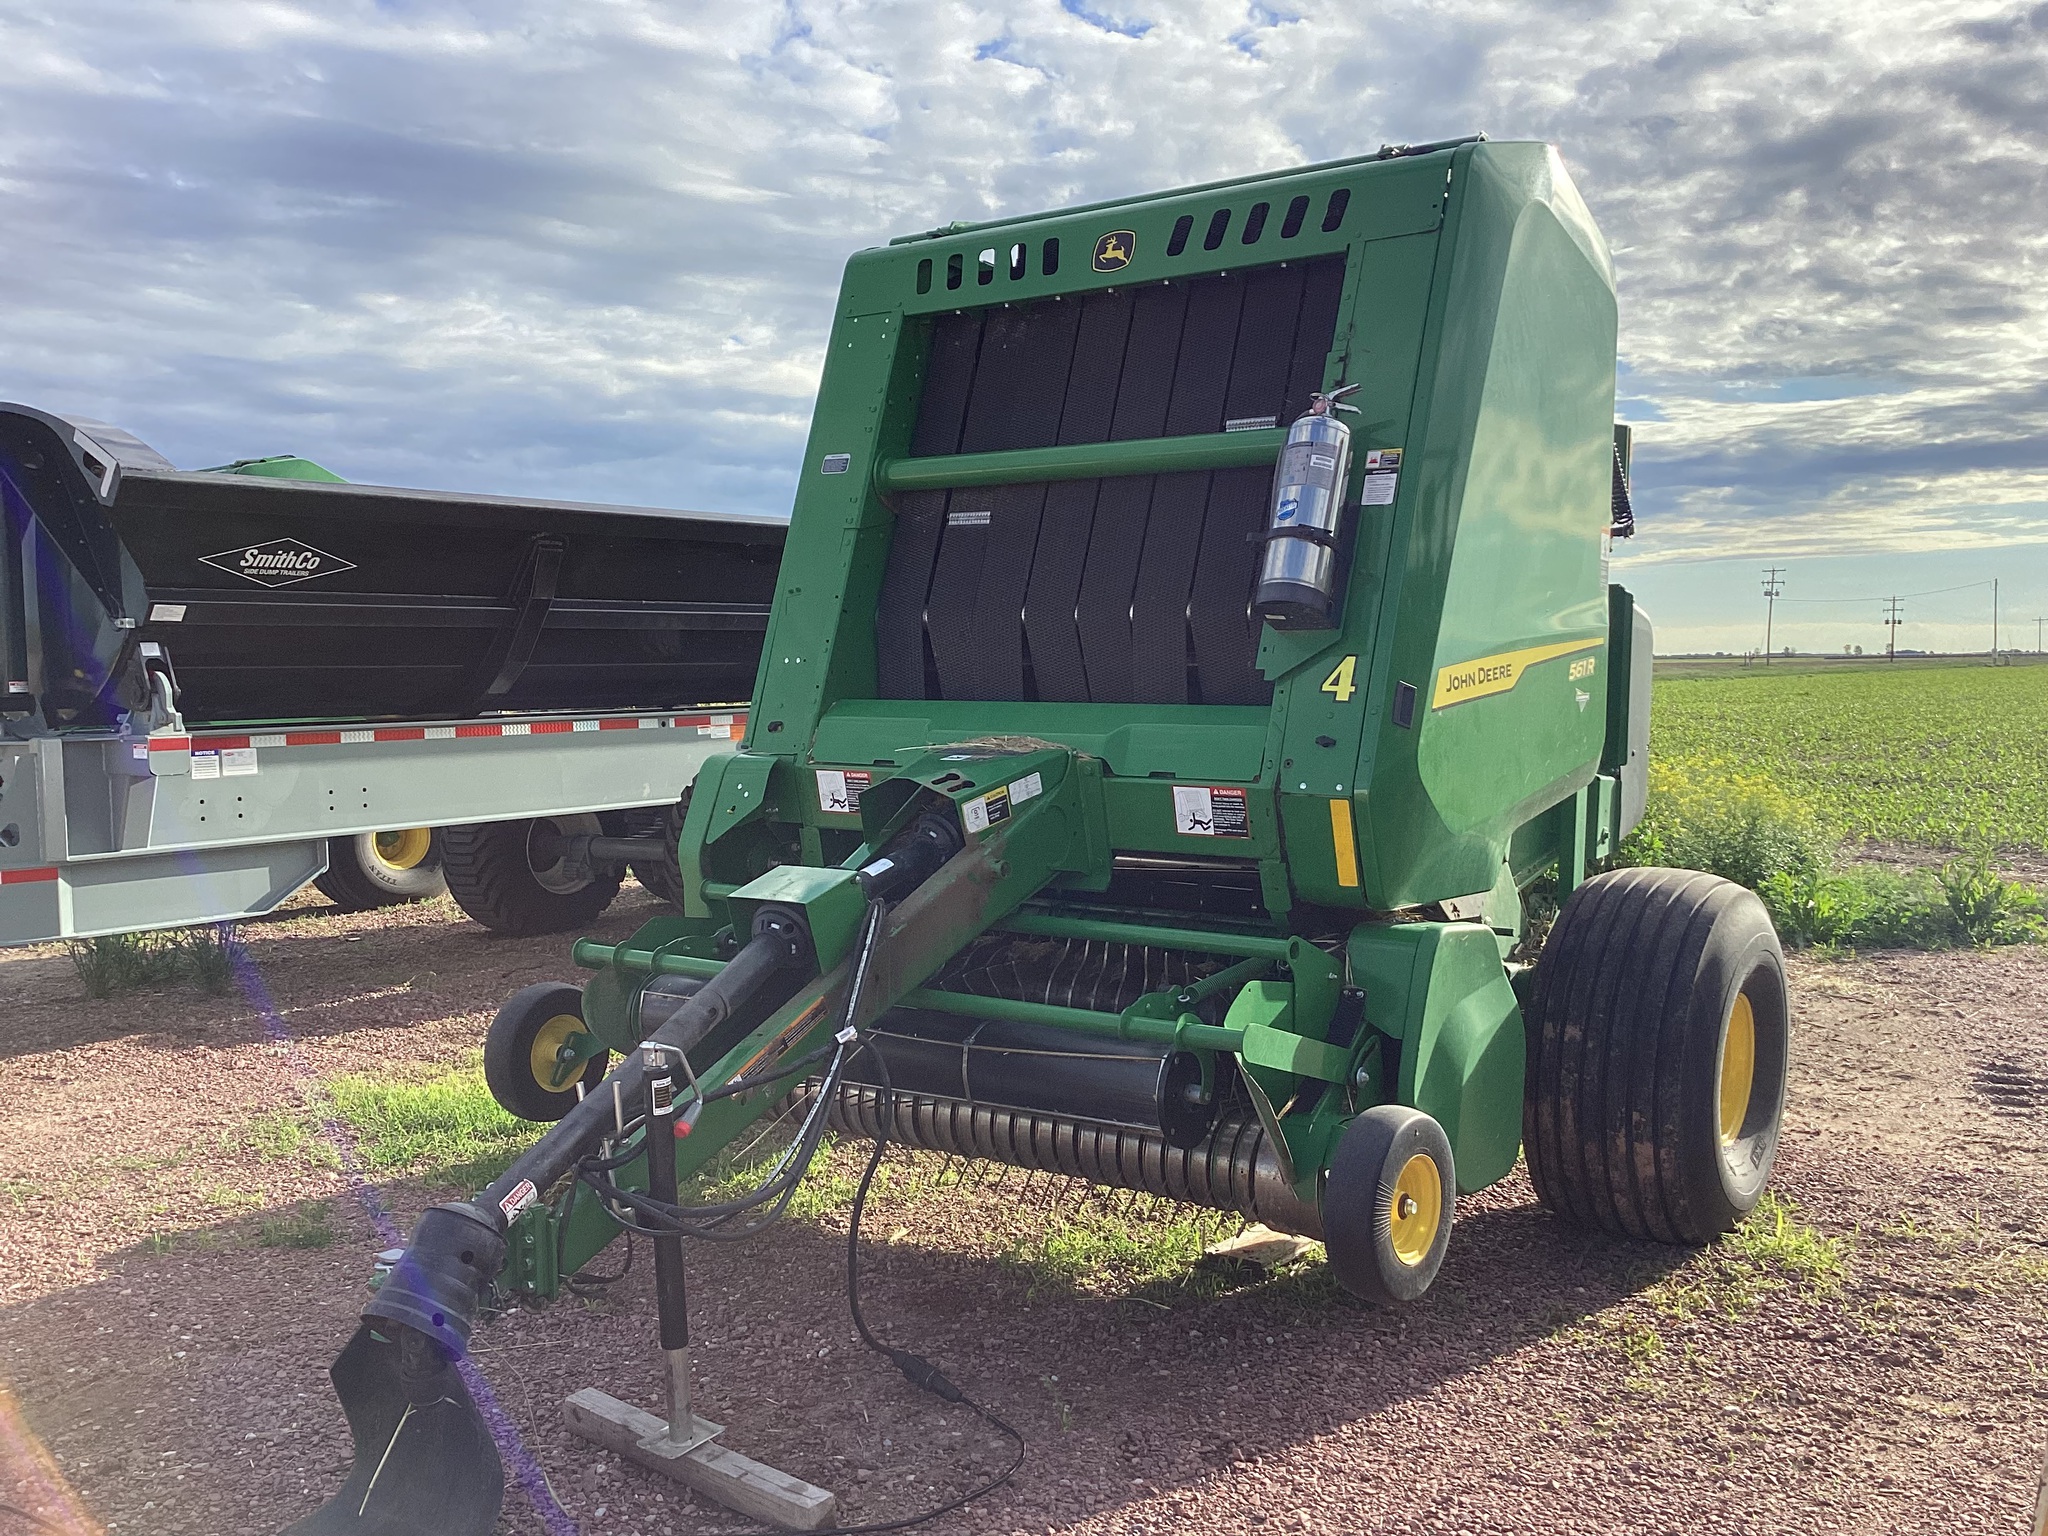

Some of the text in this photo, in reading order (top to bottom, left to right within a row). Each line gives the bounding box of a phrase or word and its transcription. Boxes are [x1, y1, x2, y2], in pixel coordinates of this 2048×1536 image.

[240, 549, 320, 570] SmithCo
[280, 569, 309, 577] TRAILERS
[1321, 655, 1357, 701] 4
[1446, 663, 1512, 692] JOHN DEERE
[368, 864, 398, 886] TITAN
[509, 1182, 532, 1205] DANGER
